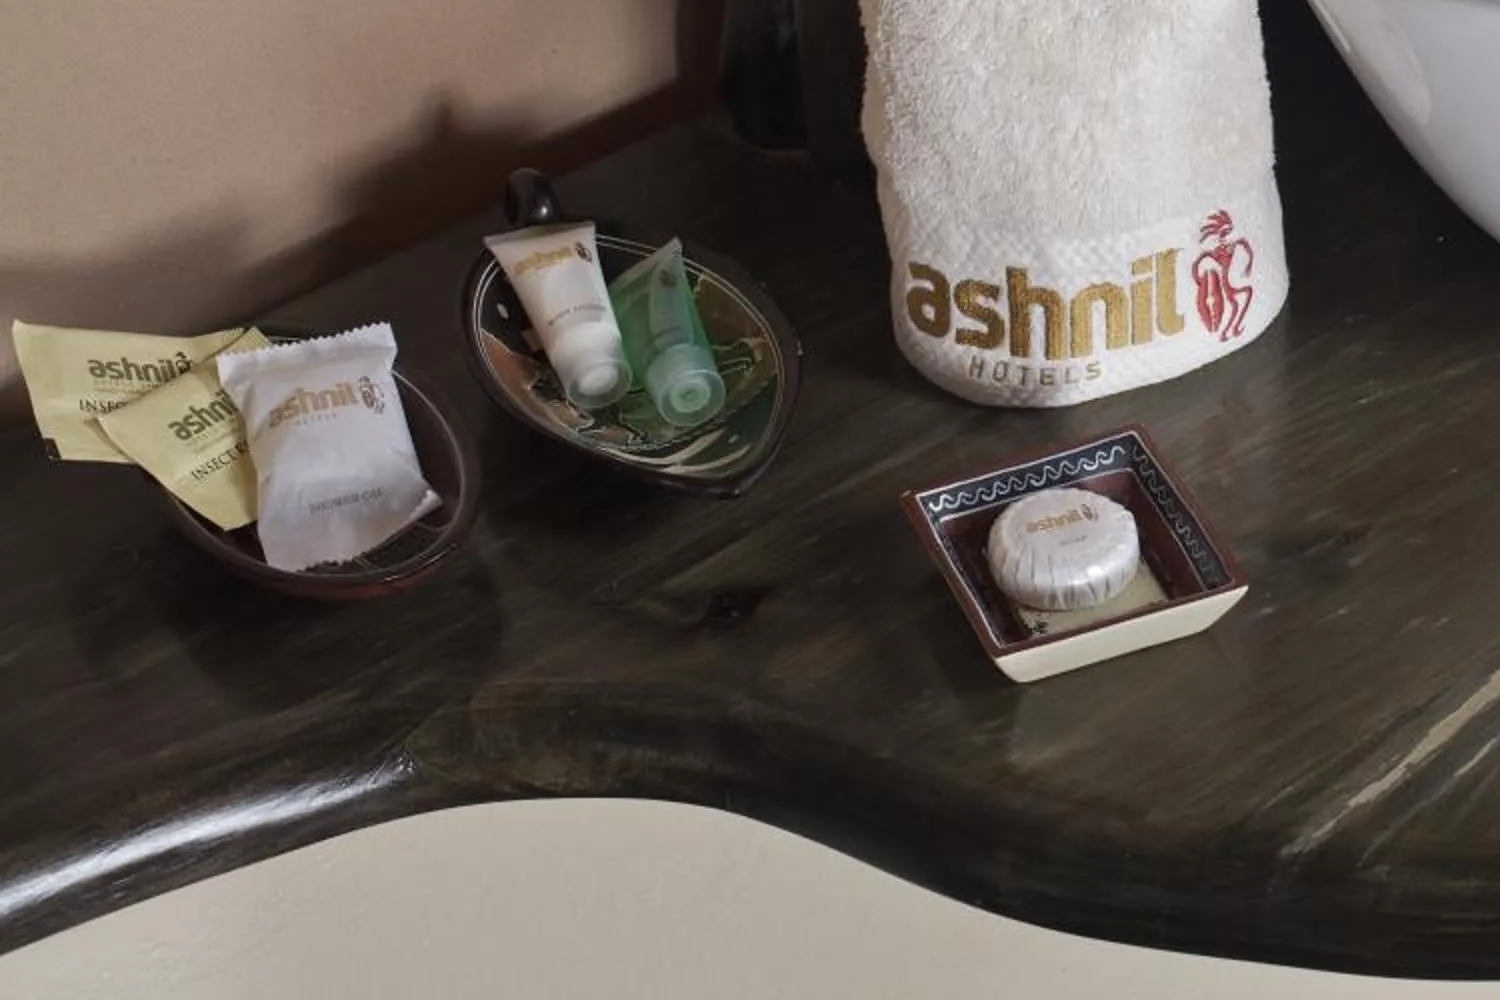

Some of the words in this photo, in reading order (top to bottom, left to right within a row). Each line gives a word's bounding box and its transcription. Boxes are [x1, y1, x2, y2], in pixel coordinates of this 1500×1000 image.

[907, 246, 1186, 362] ashnil
[87, 356, 177, 383] ashnil
[967, 355, 1103, 388] HOTELS
[167, 387, 240, 441] ashni
